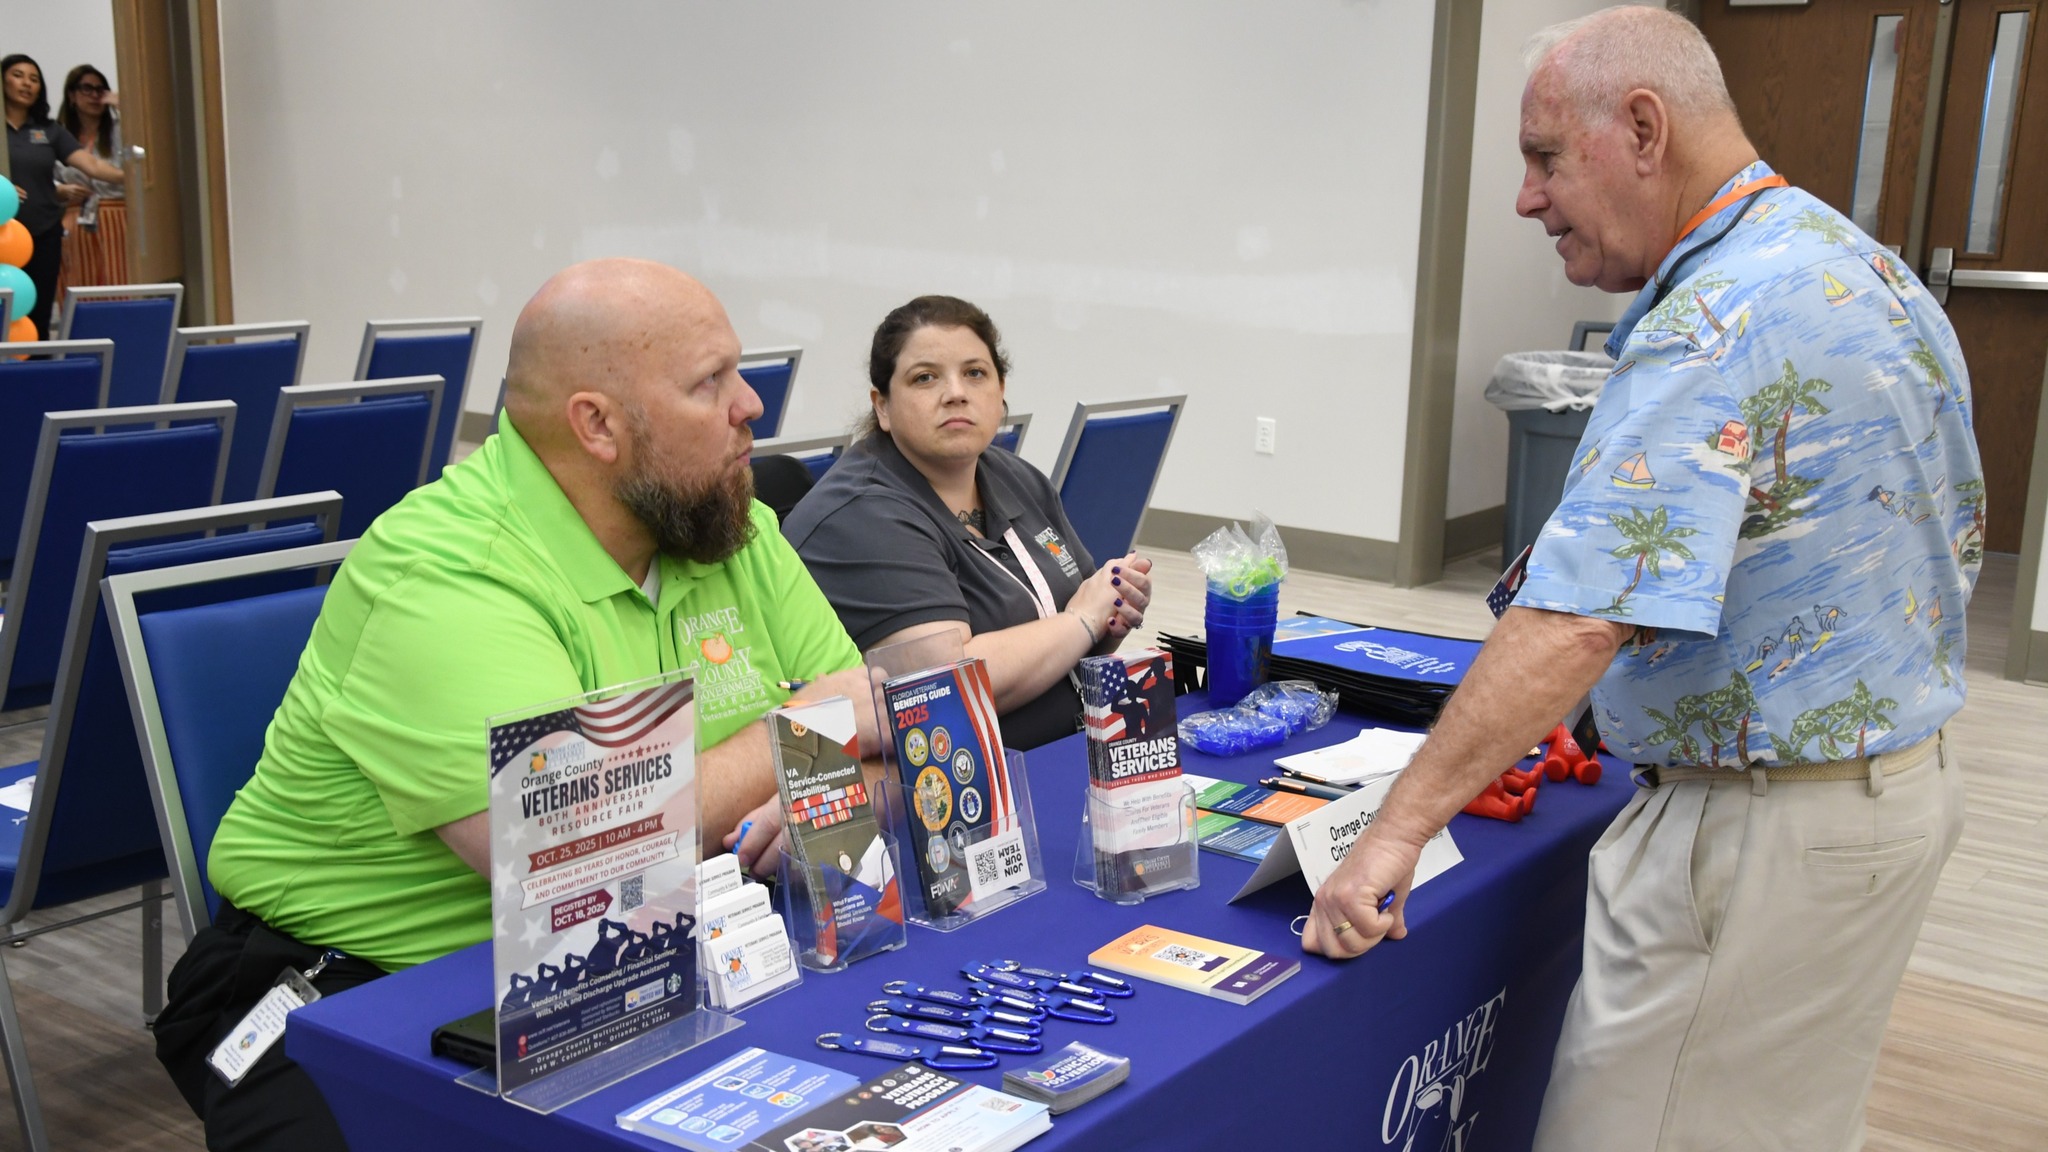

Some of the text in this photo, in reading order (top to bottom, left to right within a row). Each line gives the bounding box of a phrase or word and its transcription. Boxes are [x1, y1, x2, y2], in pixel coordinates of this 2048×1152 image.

[678, 606, 744, 646] ORANGE
[892, 690, 913, 702] FLORIDA
[894, 686, 951, 712] BENEFITS GUIDE
[896, 704, 929, 730] 2025
[1109, 736, 1176, 762] VETERANS
[522, 758, 604, 789] Orange County
[786, 768, 798, 778] VA
[788, 765, 856, 789] Service-Connected
[1112, 752, 1177, 778] SERVICES
[522, 774, 599, 819] VETERANS
[605, 753, 672, 794] SERVICES
[791, 784, 830, 800] Disabilities
[576, 785, 655, 816] ANNIVERSARY
[552, 801, 644, 836] RESOURCE FAIR
[1330, 819, 1361, 842] Orange
[537, 853, 558, 866] OCT.
[560, 848, 573, 859] 25,
[576, 838, 596, 854] 2025
[606, 832, 616, 843] 10
[617, 828, 630, 840] AM
[638, 824, 643, 834] 4
[644, 818, 658, 831] PM
[998, 843, 1020, 859] TEAM
[527, 868, 572, 891] CELEBRATING
[584, 860, 603, 872] YEARS
[605, 856, 614, 865] OF
[1004, 863, 1023, 877] JOIN
[1005, 854, 1022, 866] OUR
[535, 851, 665, 901] AND COMMITMENT TO OUR COMMUNITY
[554, 894, 597, 916] REGISTER BY
[554, 903, 606, 927] OCT. 18, 2025
[532, 993, 558, 1009] Vendors
[563, 982, 588, 996] Benefits
[589, 969, 623, 987] Counseling
[627, 956, 653, 972] Financial
[654, 947, 677, 963] Seminar
[570, 994, 582, 1004] and
[583, 978, 612, 1000] Discharge
[614, 972, 639, 989] Upgrade
[640, 961, 670, 977] Assistance
[536, 1049, 563, 1063] Orange
[566, 1038, 590, 1052] County
[593, 1016, 639, 1040] Multicultural
[642, 1007, 665, 1019] Center
[561, 1045, 592, 1062] Colonial
[610, 1026, 639, 1042] Orlando,
[1382, 985, 1506, 1144] ORANGE
[881, 1072, 936, 1100] VETERANS
[894, 1076, 948, 1105] OUTREACH
[905, 1080, 960, 1109] PROGRAM
